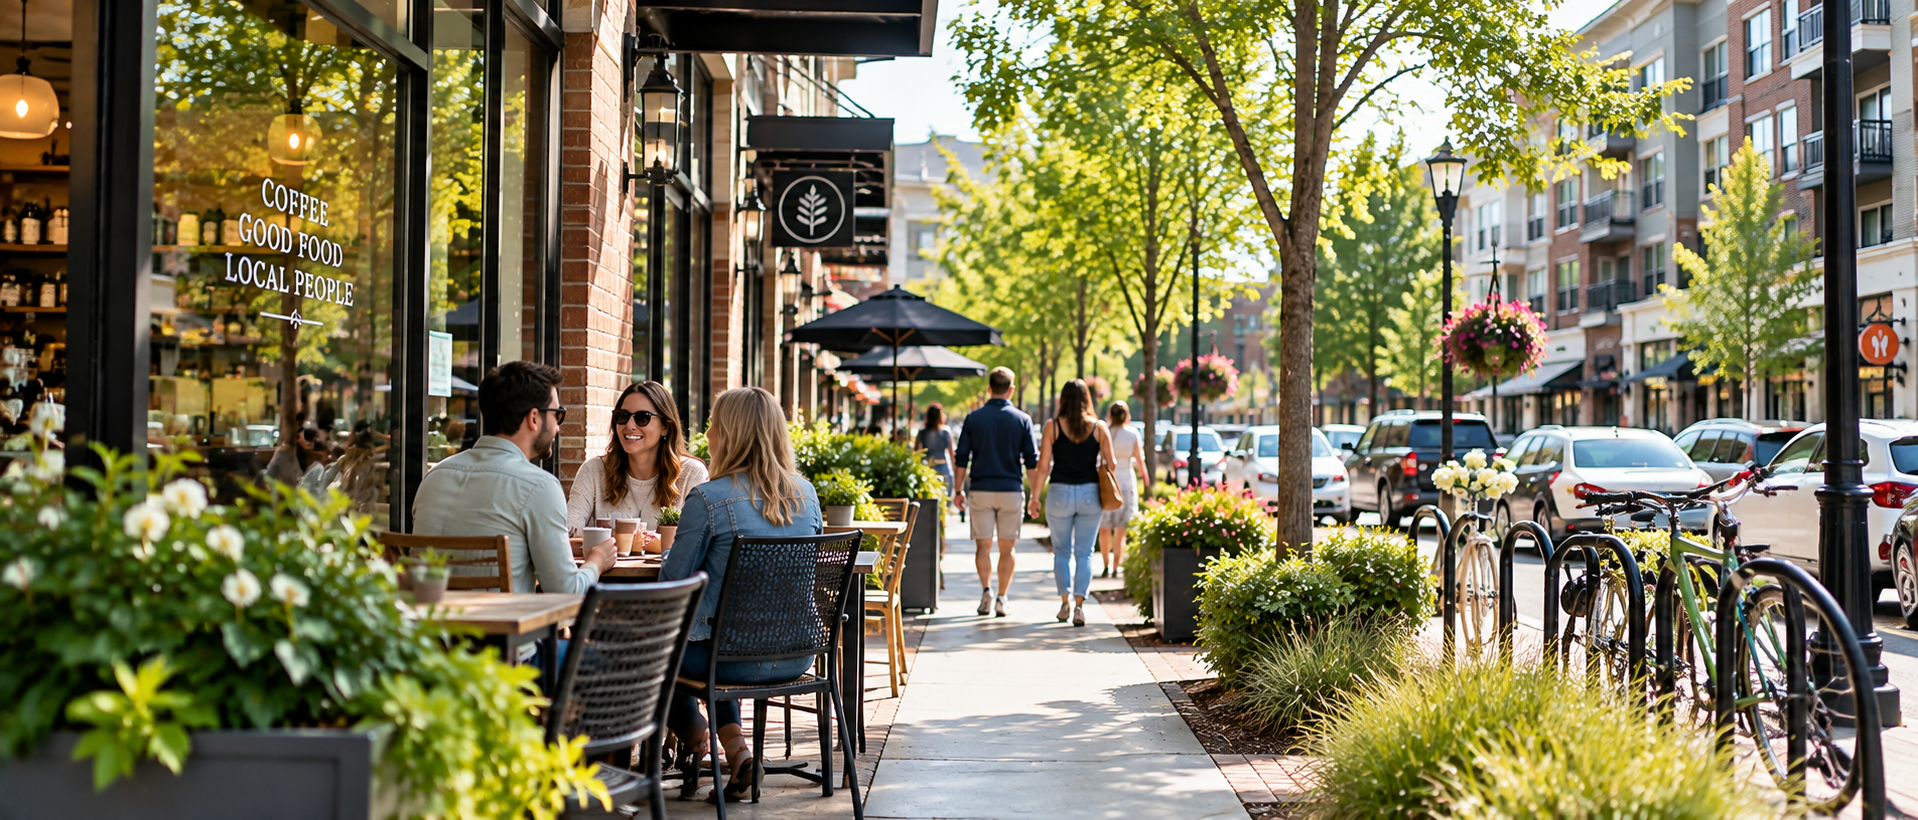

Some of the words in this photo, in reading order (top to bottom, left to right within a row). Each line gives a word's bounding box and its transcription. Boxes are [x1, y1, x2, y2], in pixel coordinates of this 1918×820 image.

[262, 178, 329, 227] COFFEE
[238, 213, 293, 254] GOOD
[297, 231, 343, 268] FOOD
[225, 252, 290, 293] LOCAL
[294, 269, 354, 307] PEOPLE
